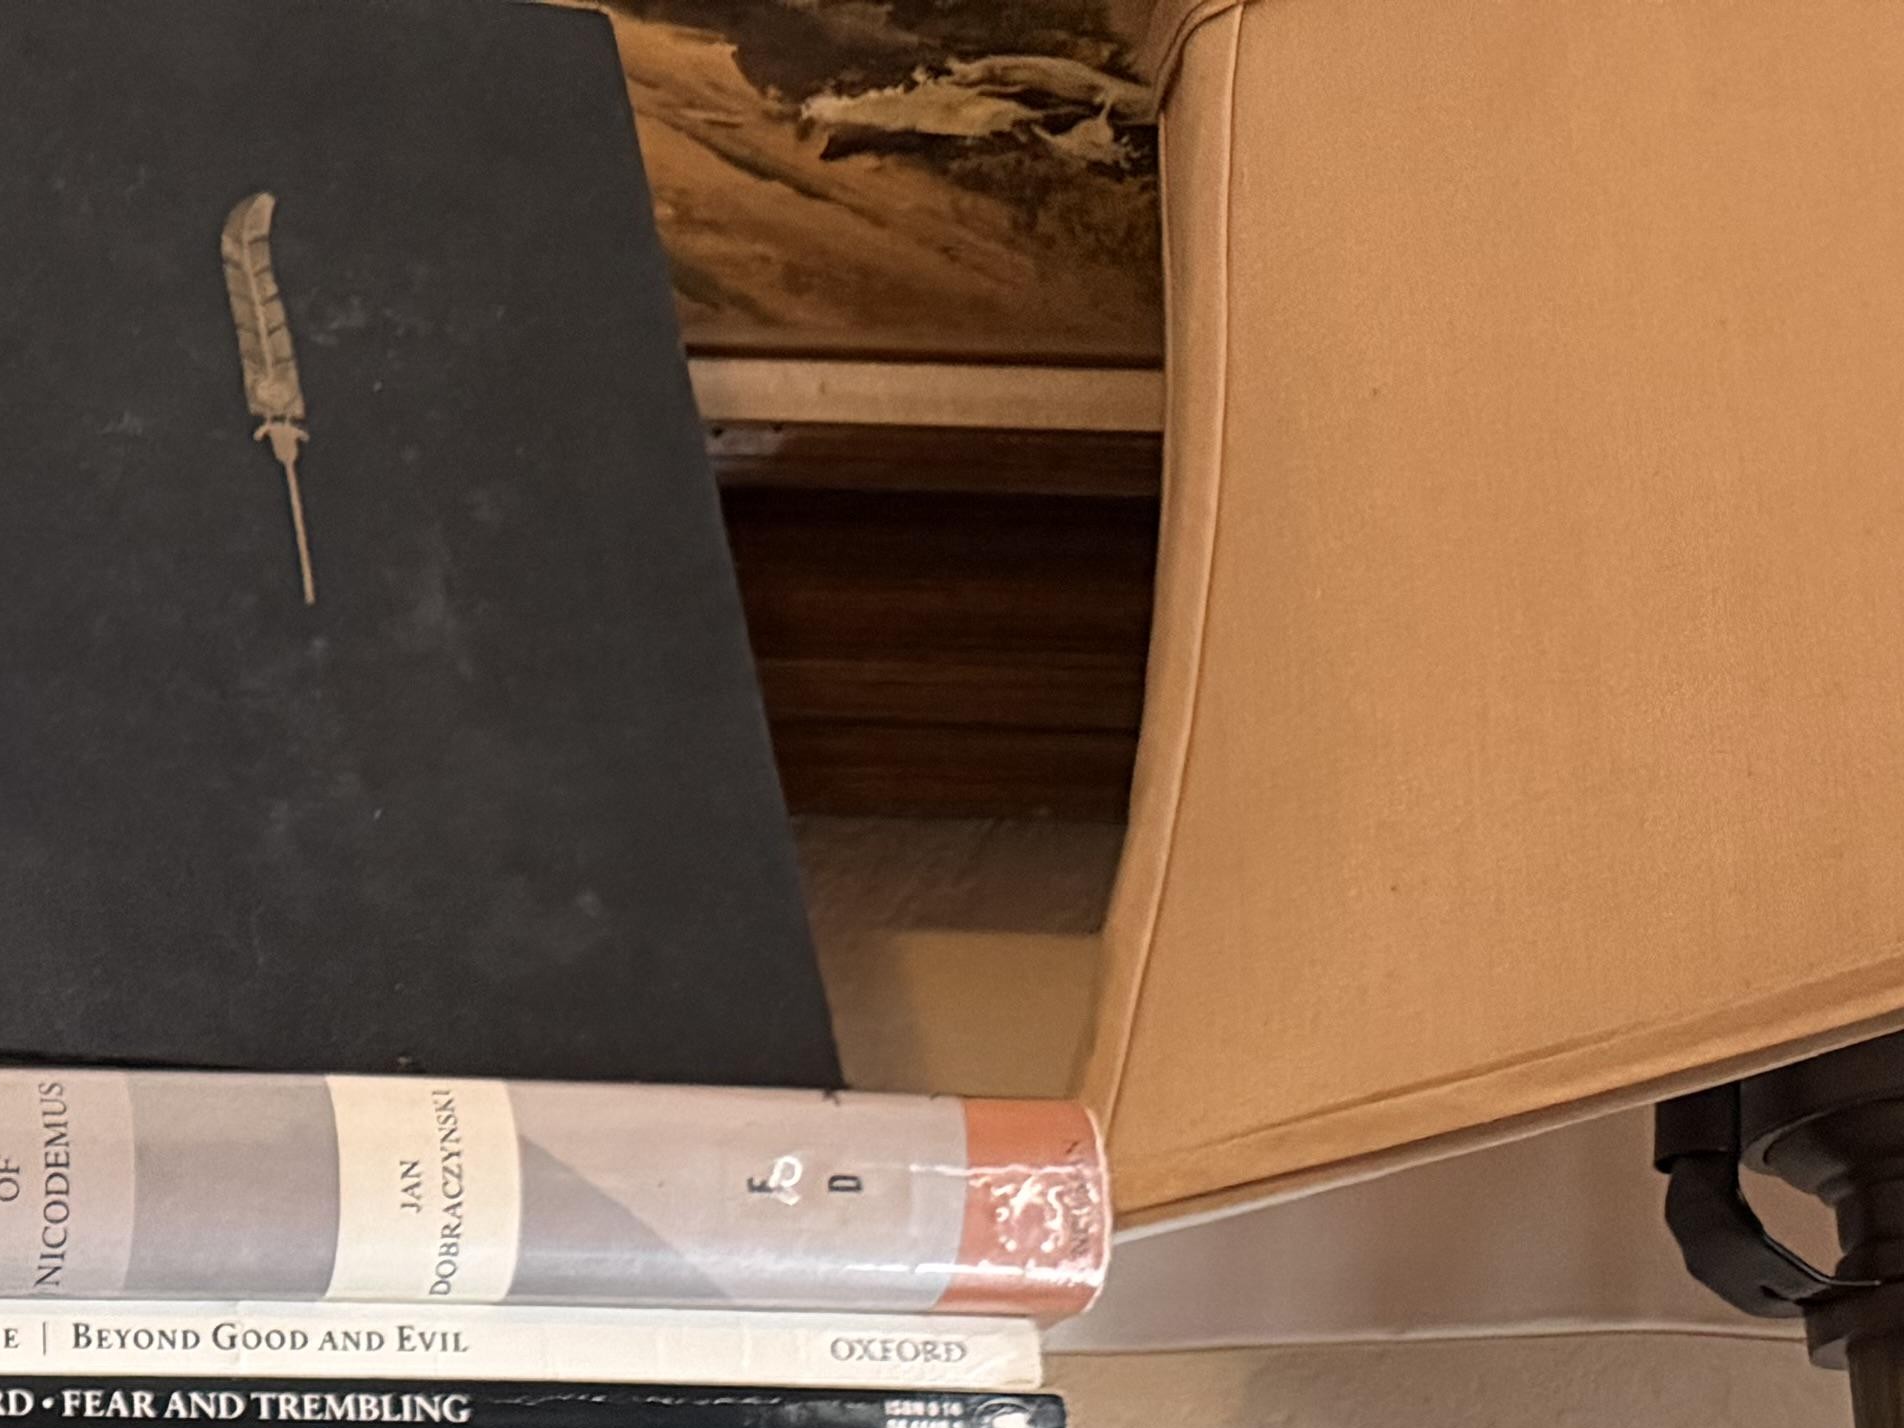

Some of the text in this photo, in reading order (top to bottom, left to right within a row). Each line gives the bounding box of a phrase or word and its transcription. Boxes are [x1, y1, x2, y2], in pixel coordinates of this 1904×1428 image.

[35, 1080, 71, 1289] NICODEMUS
[399, 1159, 422, 1214] JAN
[830, 1338, 967, 1364] OXFORD
